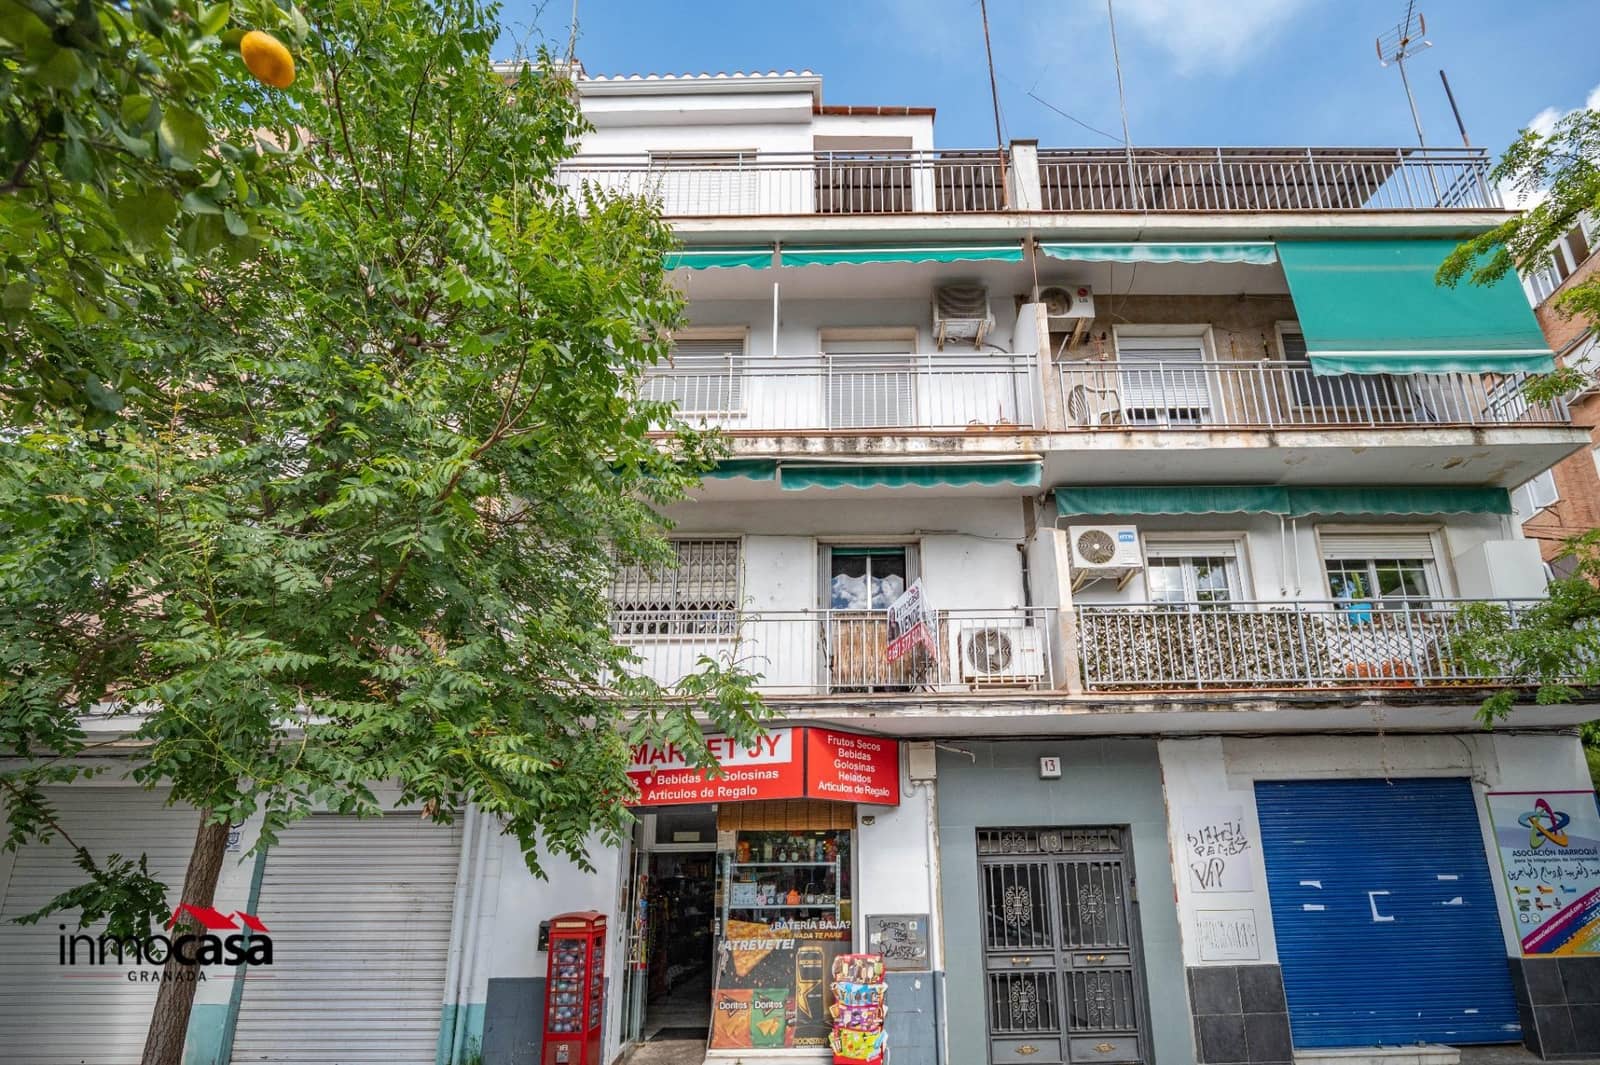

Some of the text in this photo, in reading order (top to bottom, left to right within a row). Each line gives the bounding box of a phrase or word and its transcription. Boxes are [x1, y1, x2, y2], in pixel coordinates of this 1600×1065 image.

[629, 733, 782, 765] MARET JY
[827, 735, 881, 751] Frutos Secos
[838, 748, 872, 761] Bebidas
[833, 759, 876, 773] Golosinas
[1045, 759, 1056, 771] 13
[657, 773, 701, 785] Bebidas
[838, 771, 872, 784] Helados
[700, 786, 715, 798] de
[718, 784, 758, 799] Regalo
[854, 784, 864, 794] de
[864, 785, 890, 797] Regalo
[1512, 847, 1598, 857] ASOCIACIÓN MARROQUÍ
[819, 919, 851, 930] BAJA?
[717, 938, 796, 952] ¡ATRÉVETE!
[719, 1001, 748, 1010] Doritos
[754, 1000, 783, 1009] Doritos
